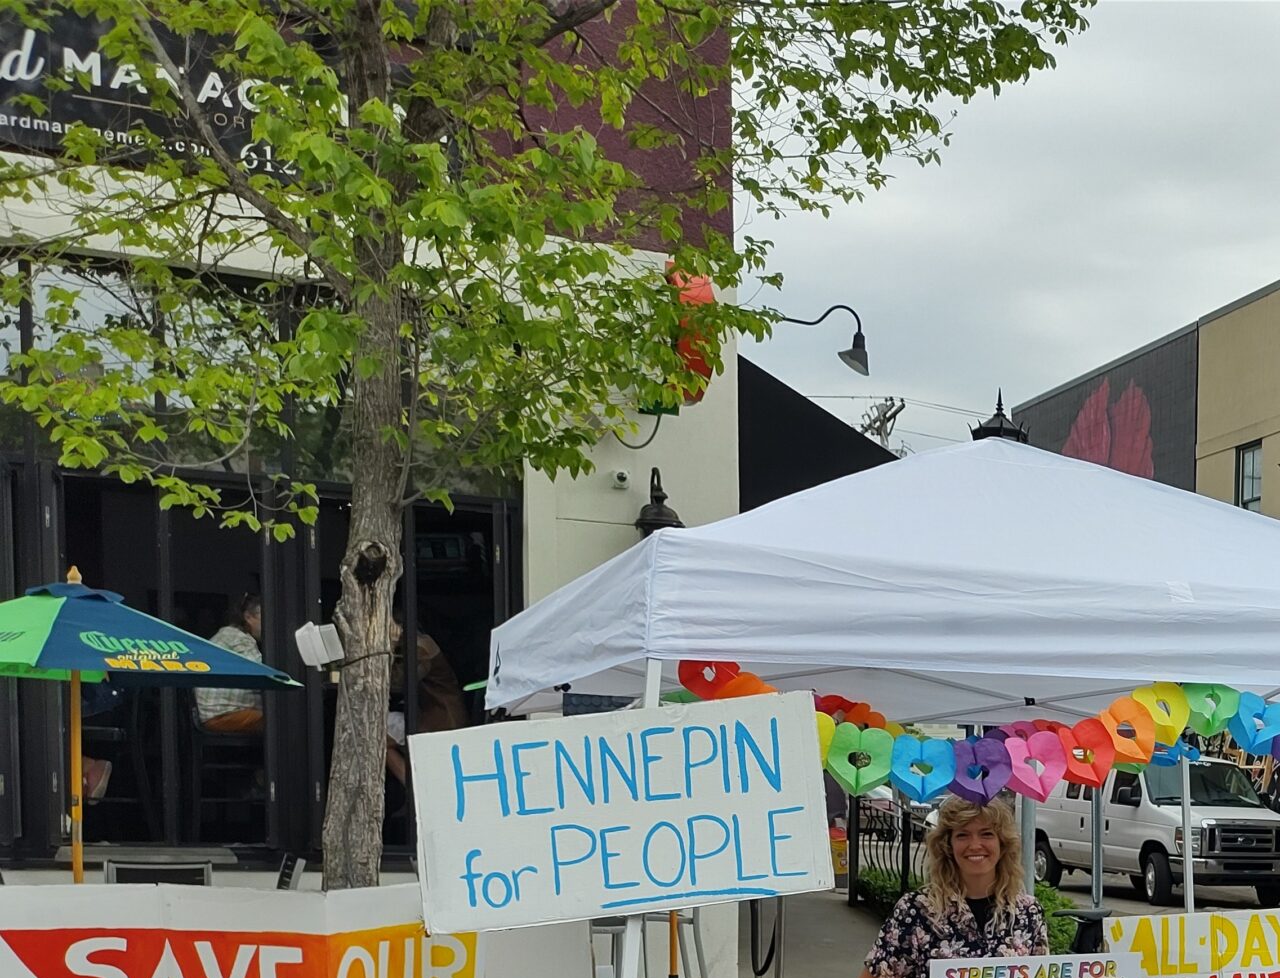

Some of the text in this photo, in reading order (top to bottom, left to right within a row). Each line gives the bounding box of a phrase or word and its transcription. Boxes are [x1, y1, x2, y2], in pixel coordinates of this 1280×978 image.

[240, 143, 297, 176] 612
[451, 716, 783, 822] HENNEPIN
[460, 806, 809, 909] for PEOPLE
[1079, 960, 1118, 978] FOR
